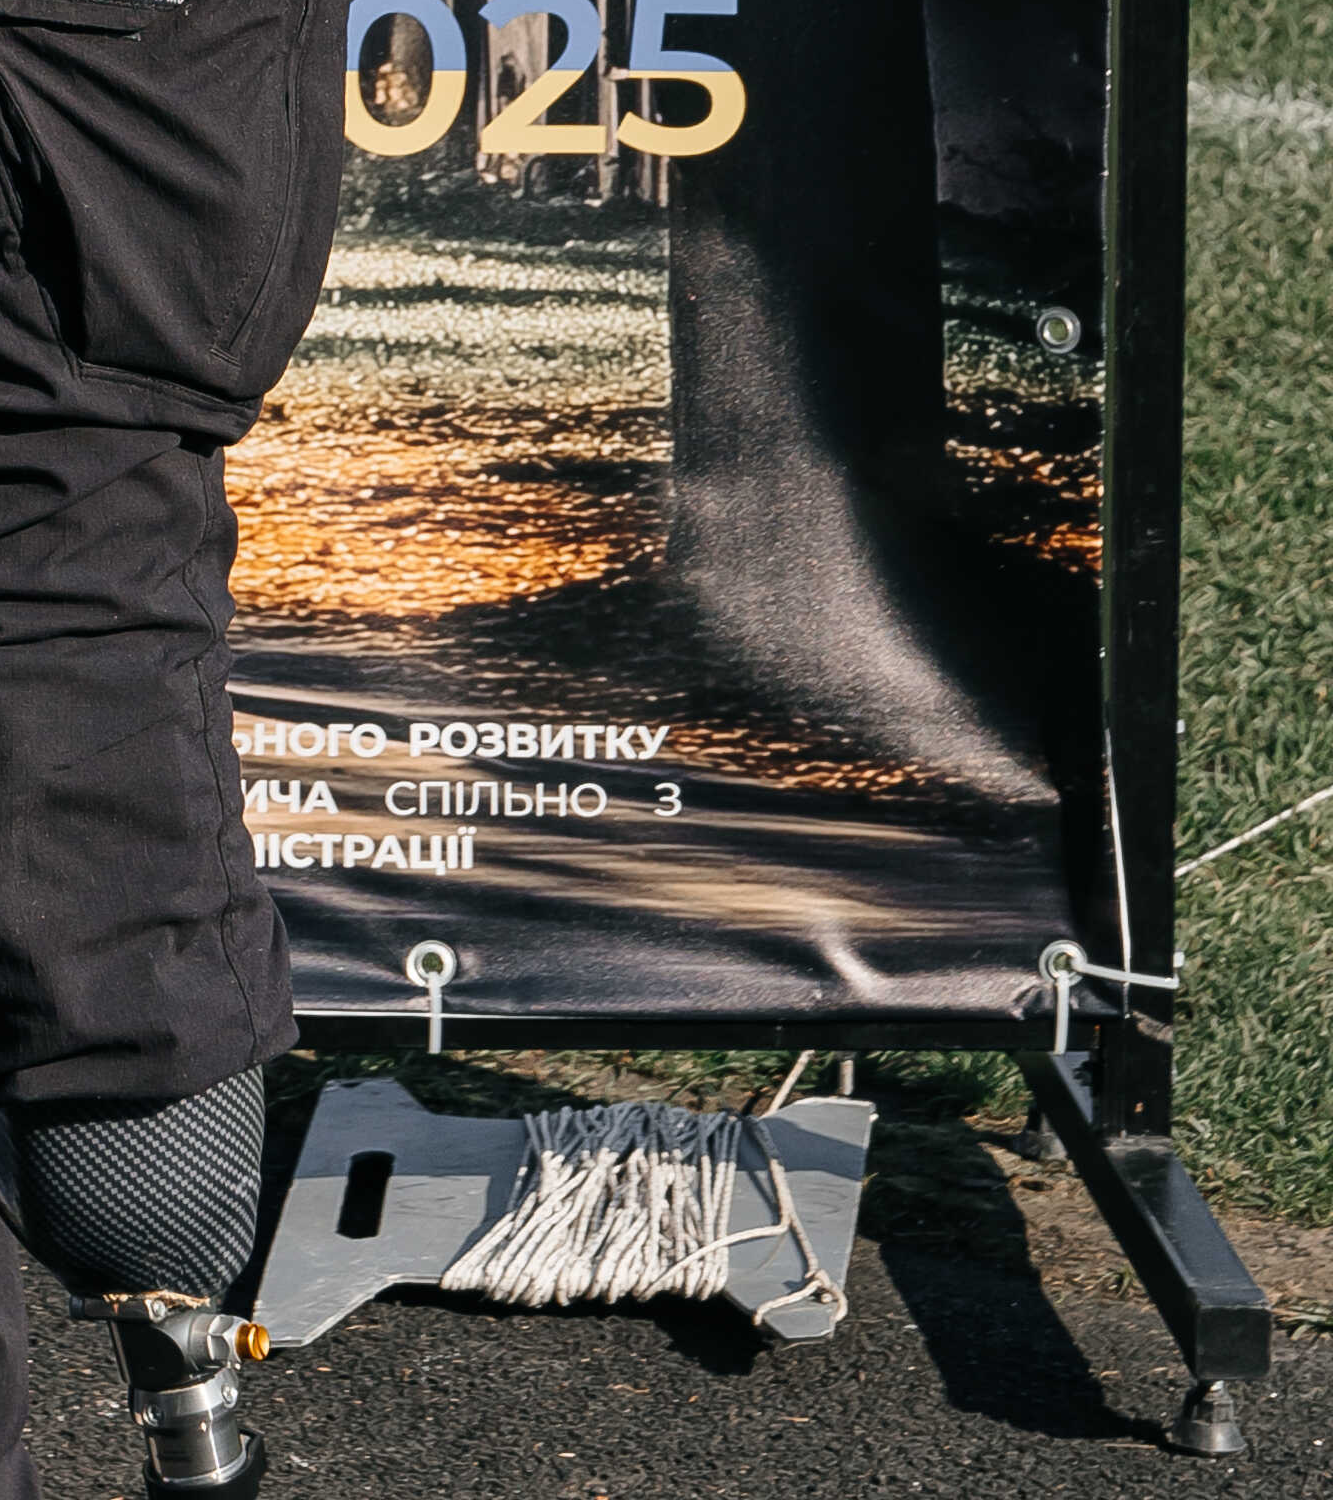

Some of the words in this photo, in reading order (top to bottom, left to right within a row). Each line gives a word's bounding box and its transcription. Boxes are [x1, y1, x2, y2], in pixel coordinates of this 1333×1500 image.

[409, 723, 670, 761] РОЗВИТКУ
[384, 780, 608, 818] СПІЛЬНО
[653, 782, 683, 817] З
